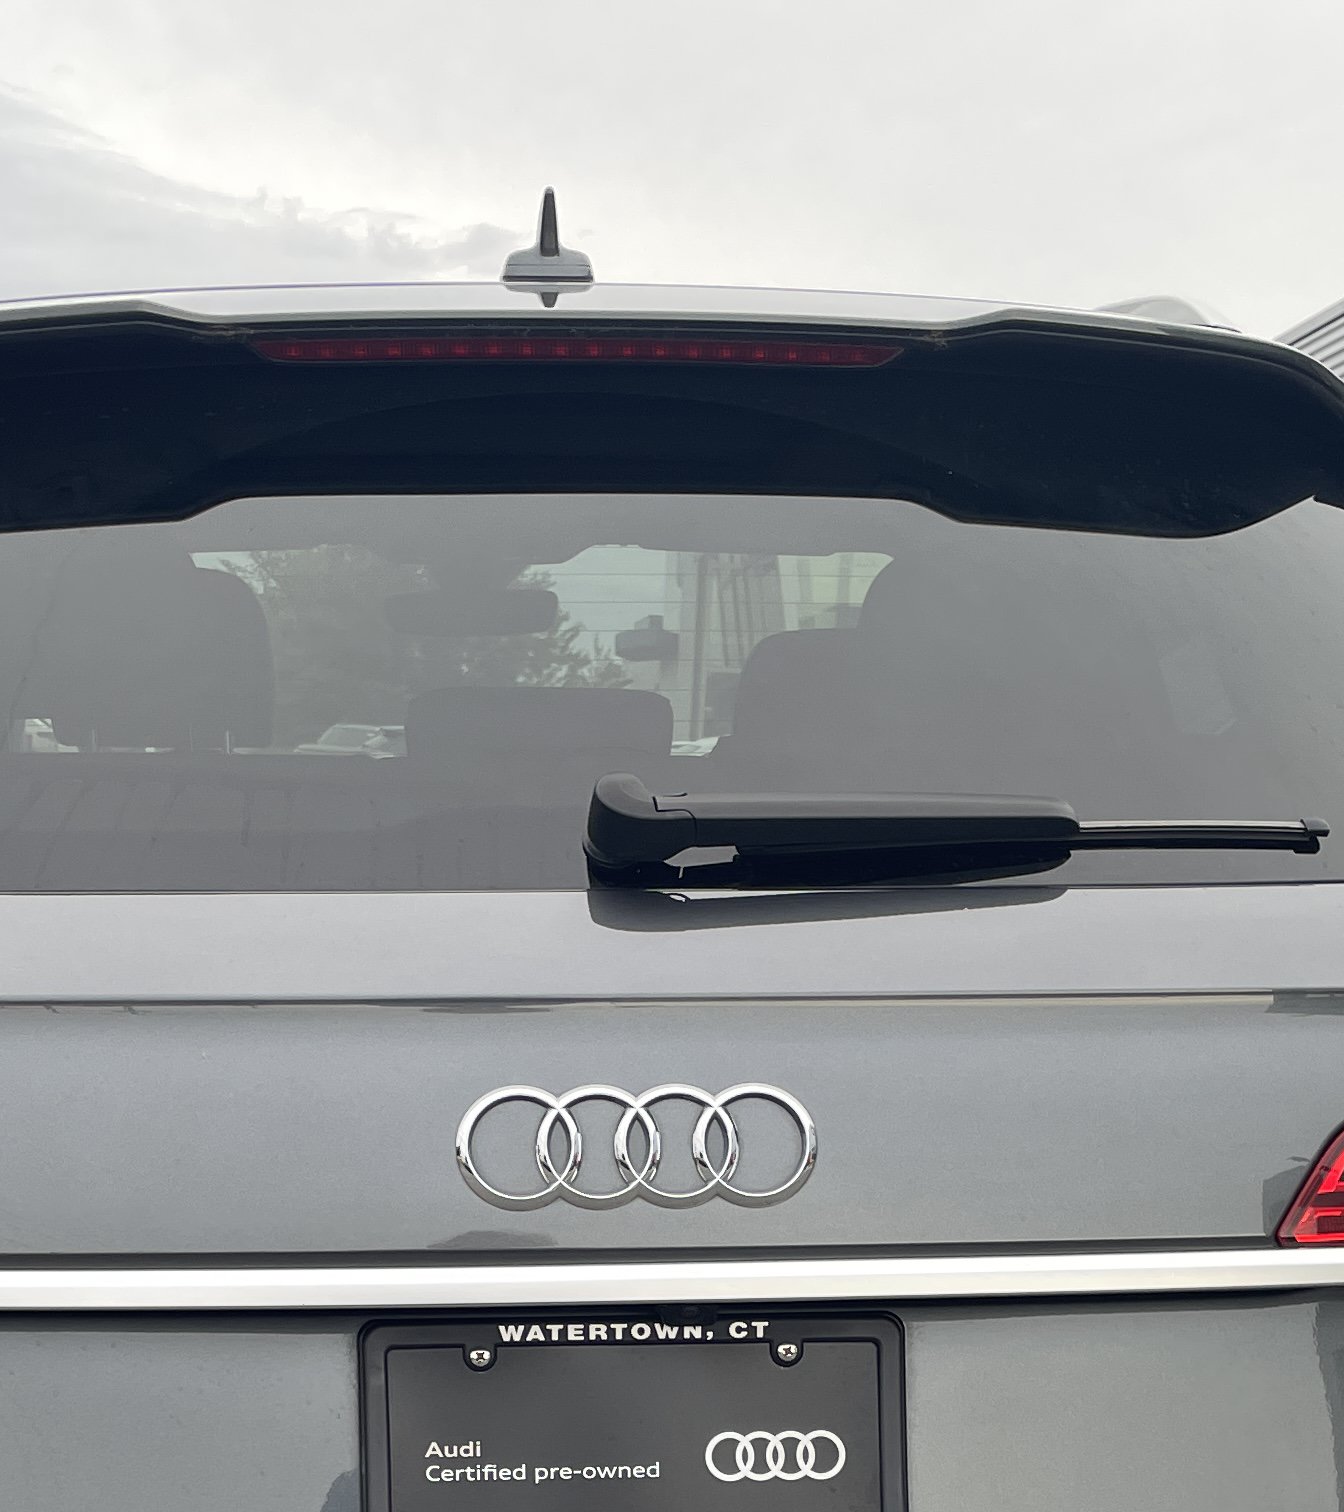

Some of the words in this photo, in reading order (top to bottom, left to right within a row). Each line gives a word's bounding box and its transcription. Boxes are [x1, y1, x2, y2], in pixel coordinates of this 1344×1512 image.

[498, 1322, 714, 1342] WATERTOWN,
[728, 1321, 770, 1339] CT
[424, 1441, 481, 1458] Audi
[425, 1464, 527, 1482] Certified
[534, 1462, 660, 1484] pre-owned
